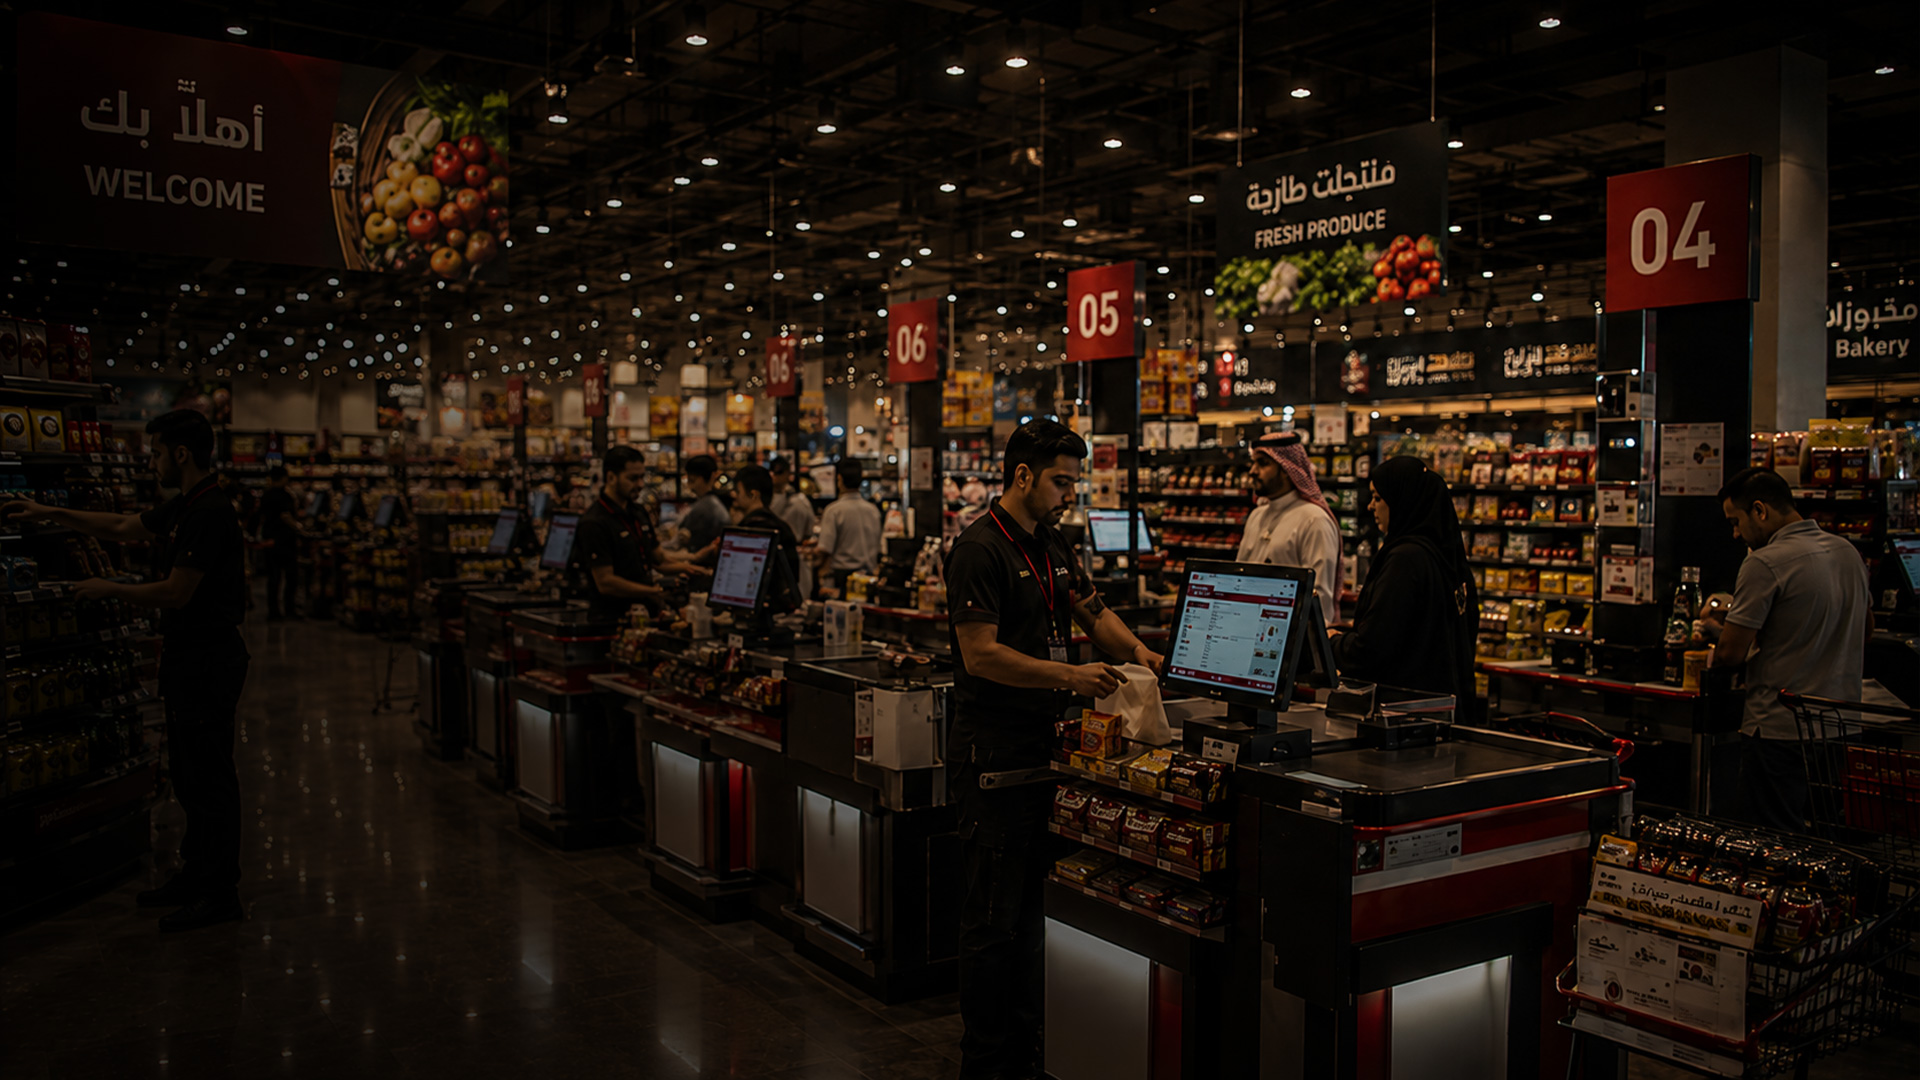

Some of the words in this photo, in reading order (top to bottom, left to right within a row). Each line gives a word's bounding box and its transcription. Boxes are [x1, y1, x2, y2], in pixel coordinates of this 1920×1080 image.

[80, 89, 151, 150] بك
[83, 164, 266, 214] WELCOME
[1254, 221, 1304, 250] FRESH
[1306, 208, 1388, 240] PRODUCE
[1630, 200, 1717, 276] 04
[1078, 289, 1120, 340] 05
[896, 322, 927, 365] 06
[1835, 336, 1911, 360] Bakery
